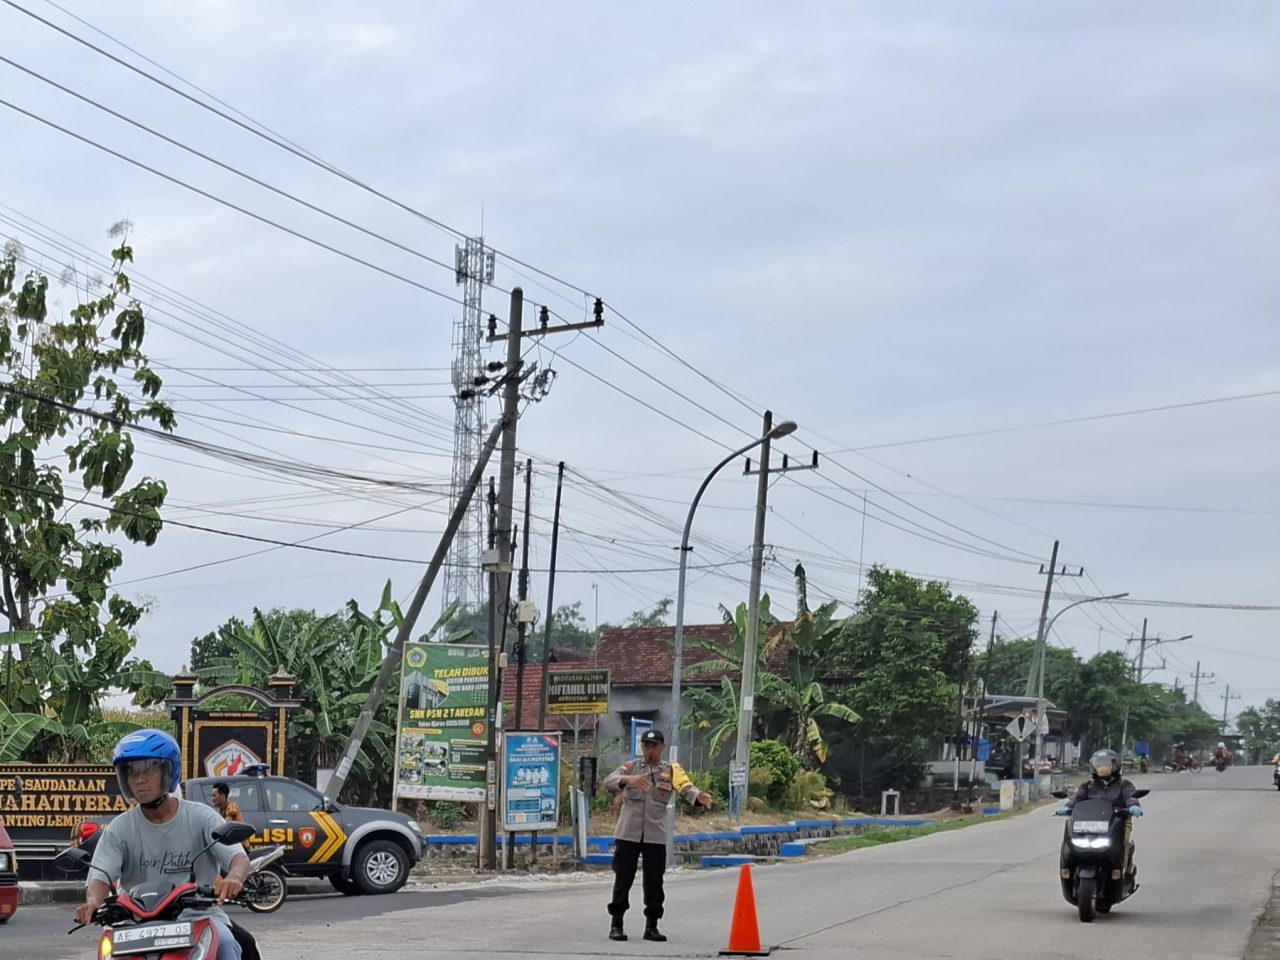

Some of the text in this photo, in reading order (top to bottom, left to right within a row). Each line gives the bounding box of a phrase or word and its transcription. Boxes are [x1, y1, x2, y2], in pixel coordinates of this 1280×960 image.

[434, 667, 489, 678] TELAH DIBUK
[548, 683, 608, 695] MIFTAHUL ULUM
[443, 708, 449, 718] 2
[450, 707, 485, 718] TAKERAN
[20, 794, 71, 811] HATI
[72, 794, 131, 811] TERA
[0, 814, 46, 828] ANTING
[250, 828, 294, 843] LISI
[117, 932, 132, 942] AE
[139, 927, 166, 939] 4927
